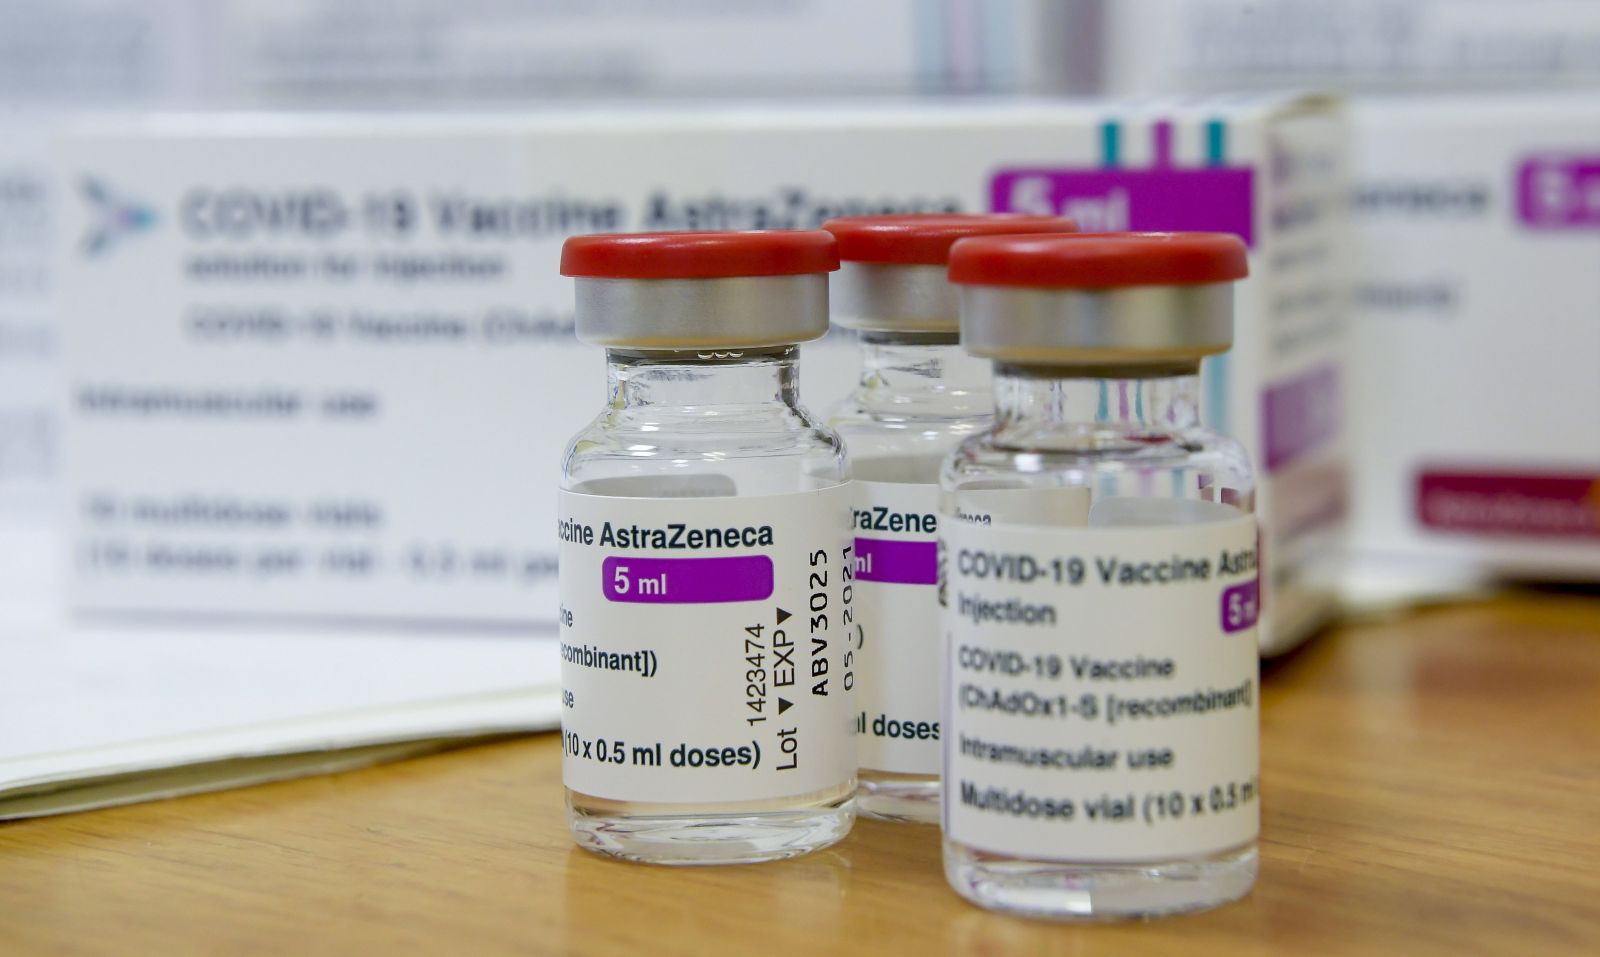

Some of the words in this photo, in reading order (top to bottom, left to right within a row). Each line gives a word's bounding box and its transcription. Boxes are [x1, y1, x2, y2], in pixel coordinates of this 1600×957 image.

[600, 521, 774, 549] AstraZeneca
[614, 566, 630, 594] 5
[638, 573, 667, 595] ml
[959, 549, 1085, 585] COVID-19
[1096, 554, 1210, 586] Vaccine
[809, 549, 829, 696] ABV3025
[842, 545, 854, 691] 05-2021
[958, 591, 1057, 626] Injection
[745, 623, 767, 726] 1423474
[773, 629, 794, 687] EXP
[959, 645, 1061, 679] COVID-19
[1069, 653, 1175, 680] Vaccine
[564, 729, 579, 757] (10
[583, 740, 592, 760] x
[596, 738, 626, 765] 0.5
[632, 743, 661, 766] ml
[669, 740, 761, 770] doses)
[776, 727, 797, 771] Lot
[959, 734, 1117, 769] Intramuscular
[1126, 748, 1174, 769] use
[960, 778, 1075, 820] Multidose
[1083, 792, 1135, 820] vial
[1143, 789, 1184, 825] (10
[1191, 793, 1204, 815] x
